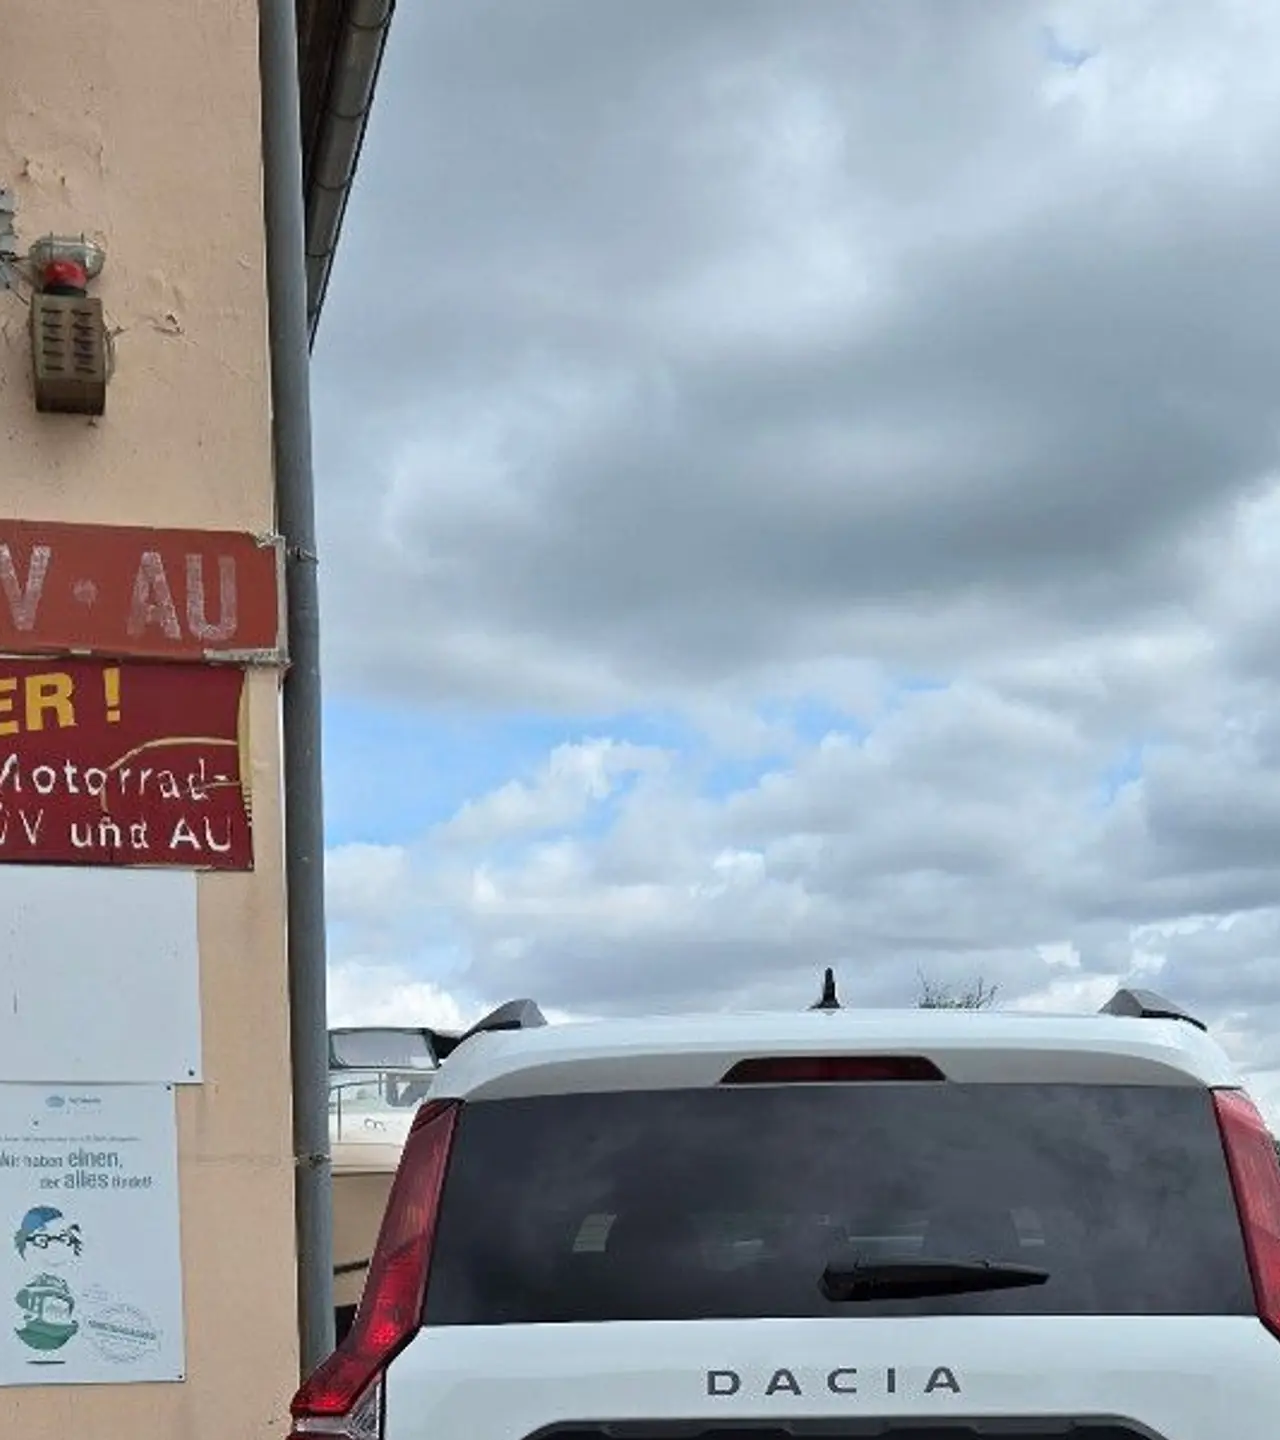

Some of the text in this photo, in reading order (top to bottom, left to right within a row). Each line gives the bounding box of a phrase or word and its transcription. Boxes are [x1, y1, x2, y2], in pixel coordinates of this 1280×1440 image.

[127, 551, 237, 640] AU
[70, 817, 149, 849] und
[170, 817, 232, 852] AU
[64, 1169, 109, 1189] alles
[706, 1366, 962, 1396] DACIA
